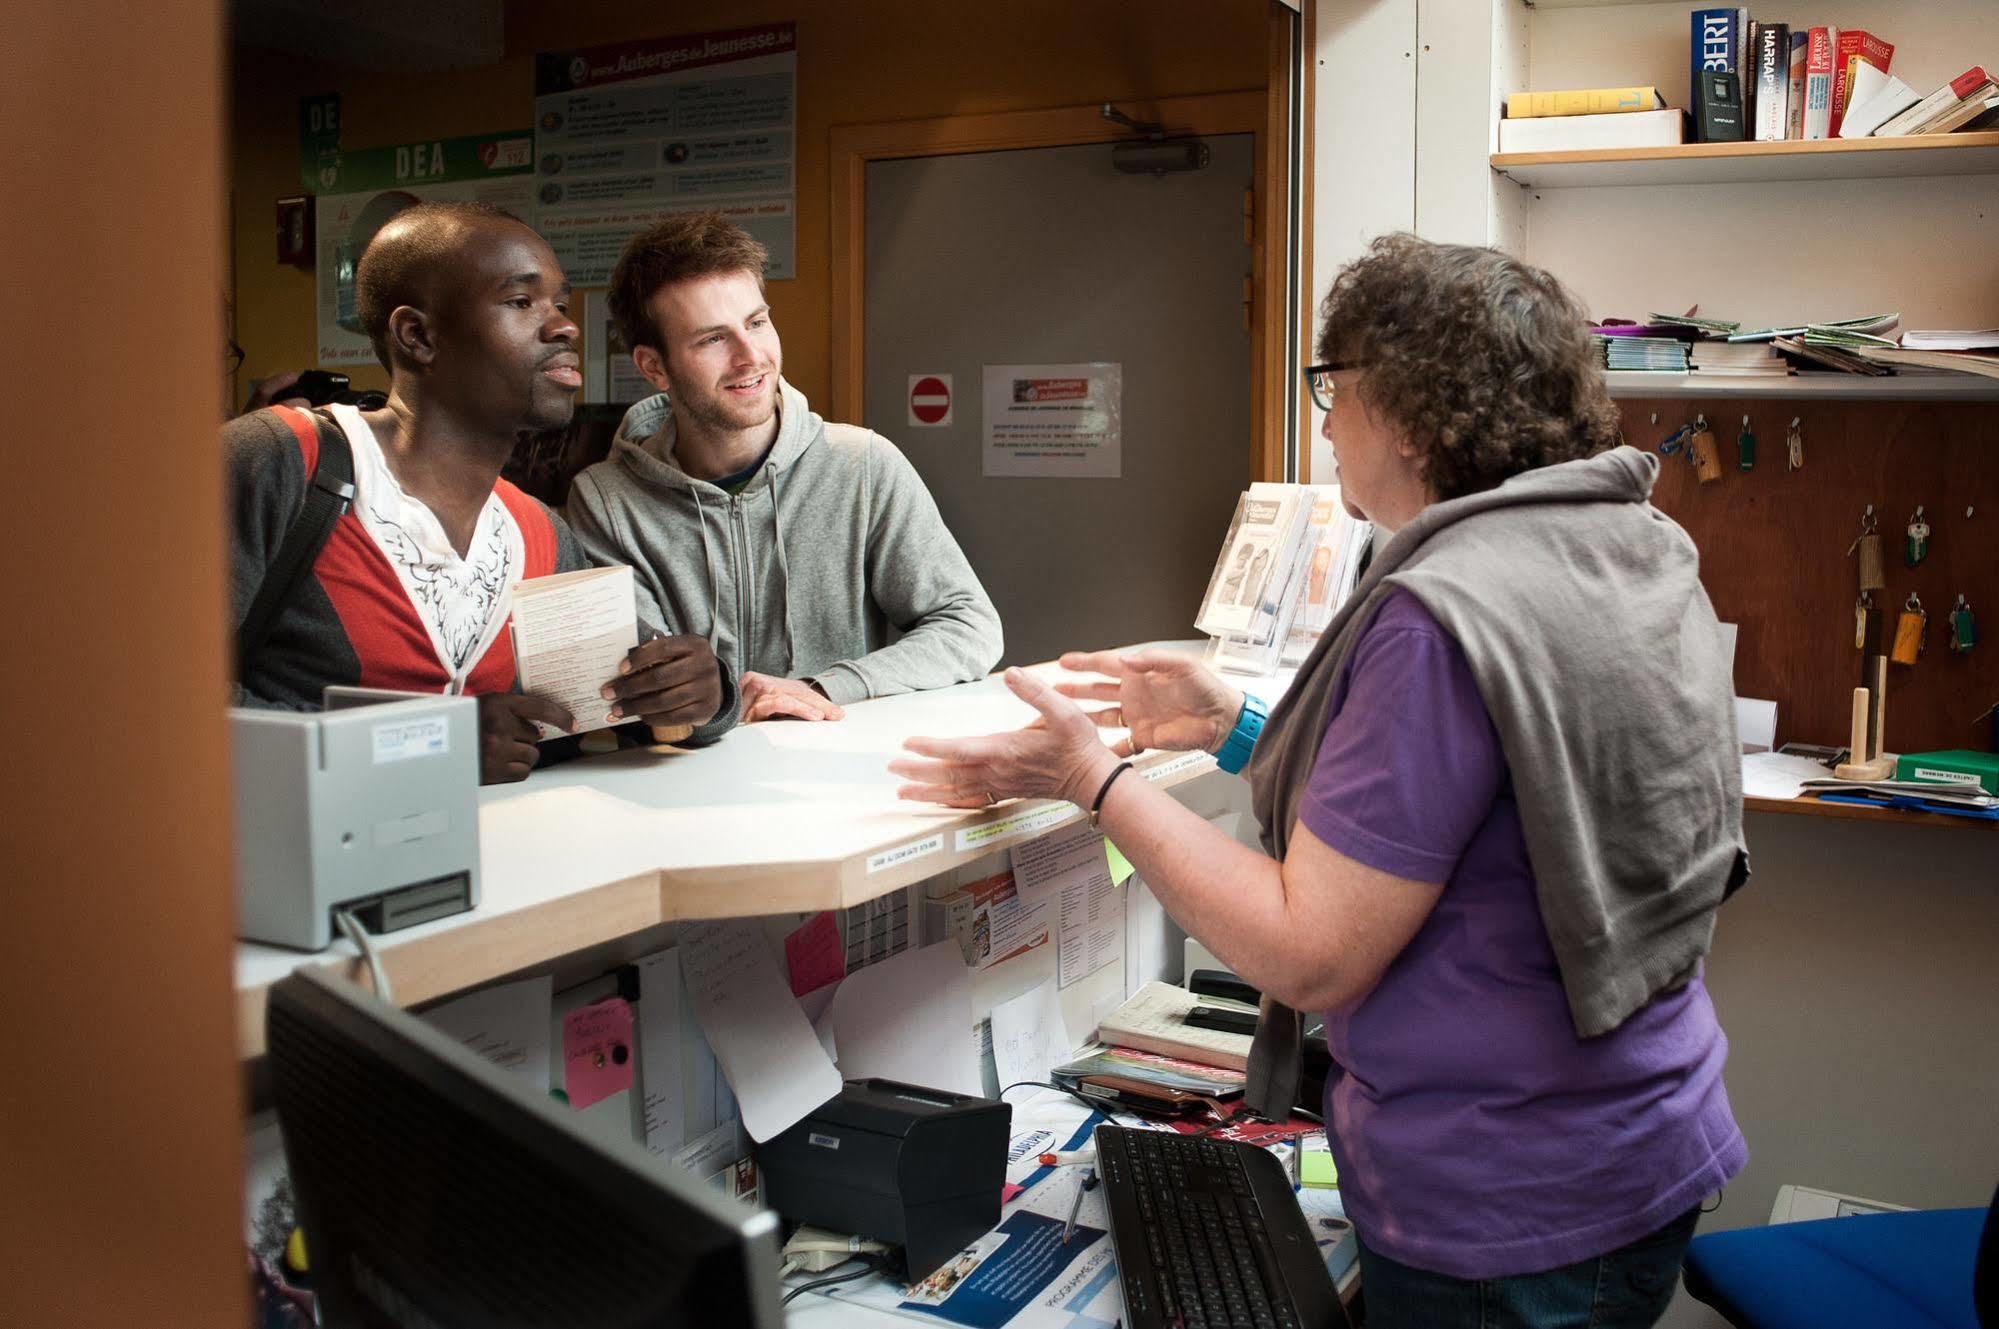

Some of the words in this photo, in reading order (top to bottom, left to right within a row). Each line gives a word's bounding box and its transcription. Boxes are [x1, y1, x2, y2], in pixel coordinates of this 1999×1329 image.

[1763, 29, 1776, 94] HARRAP'S
[1834, 68, 1847, 114] LAROUSSE
[395, 141, 446, 179] DEA
